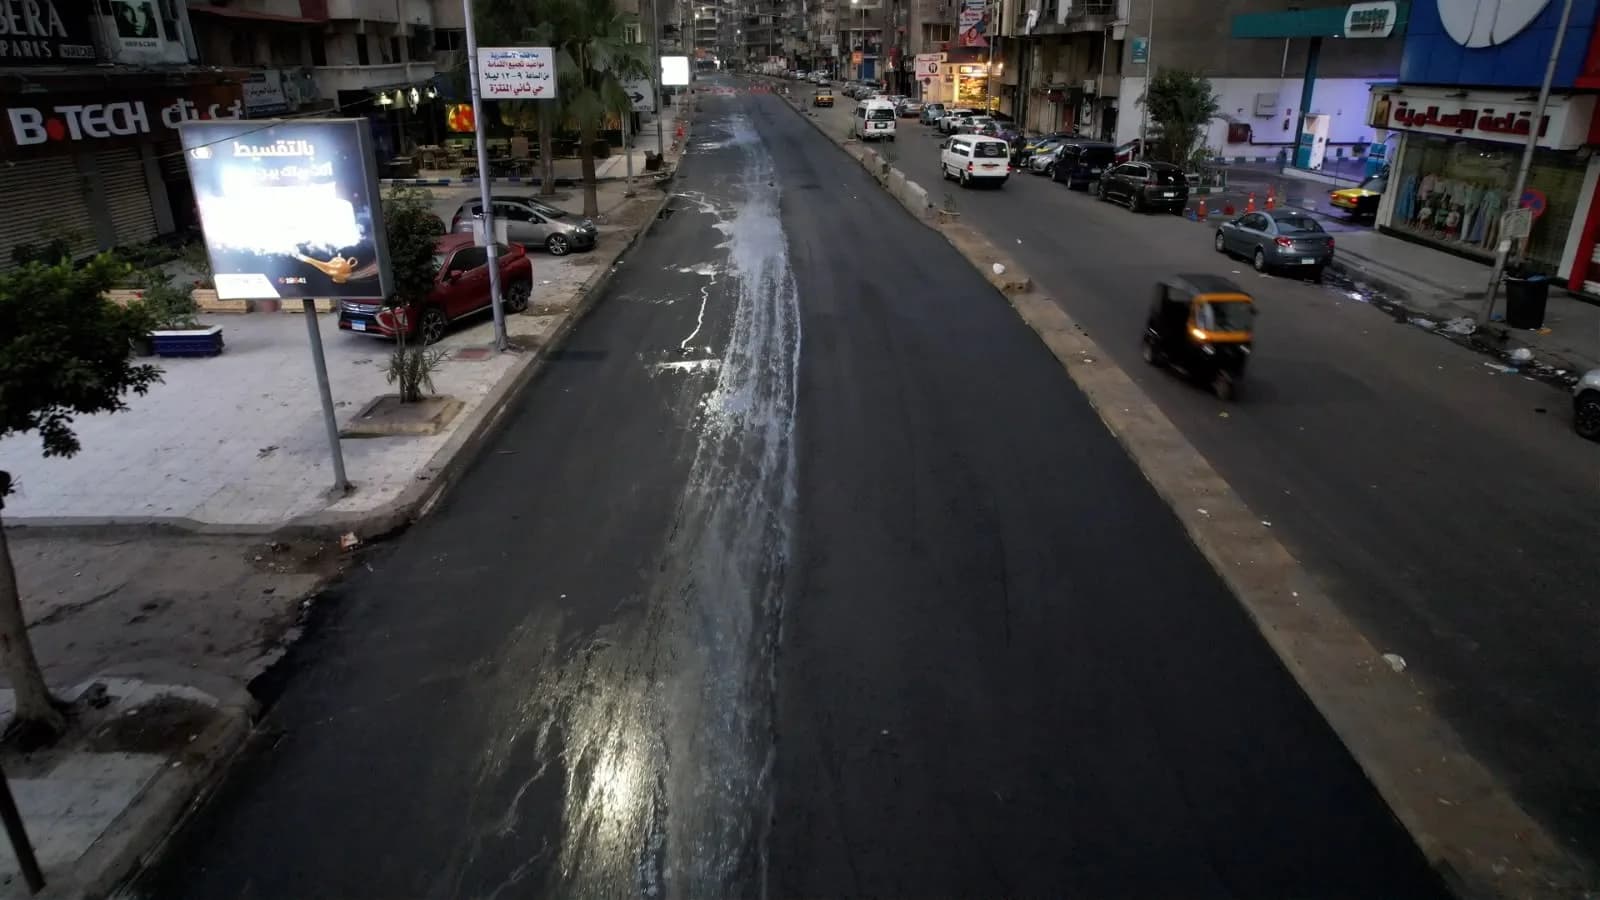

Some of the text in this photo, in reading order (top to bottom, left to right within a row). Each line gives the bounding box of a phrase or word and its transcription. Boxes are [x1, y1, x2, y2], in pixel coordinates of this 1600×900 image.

[526, 71, 542, 79] الساعة
[514, 82, 531, 95] ثاني
[533, 85, 544, 96] حي
[233, 139, 315, 161] بالتقسيط
